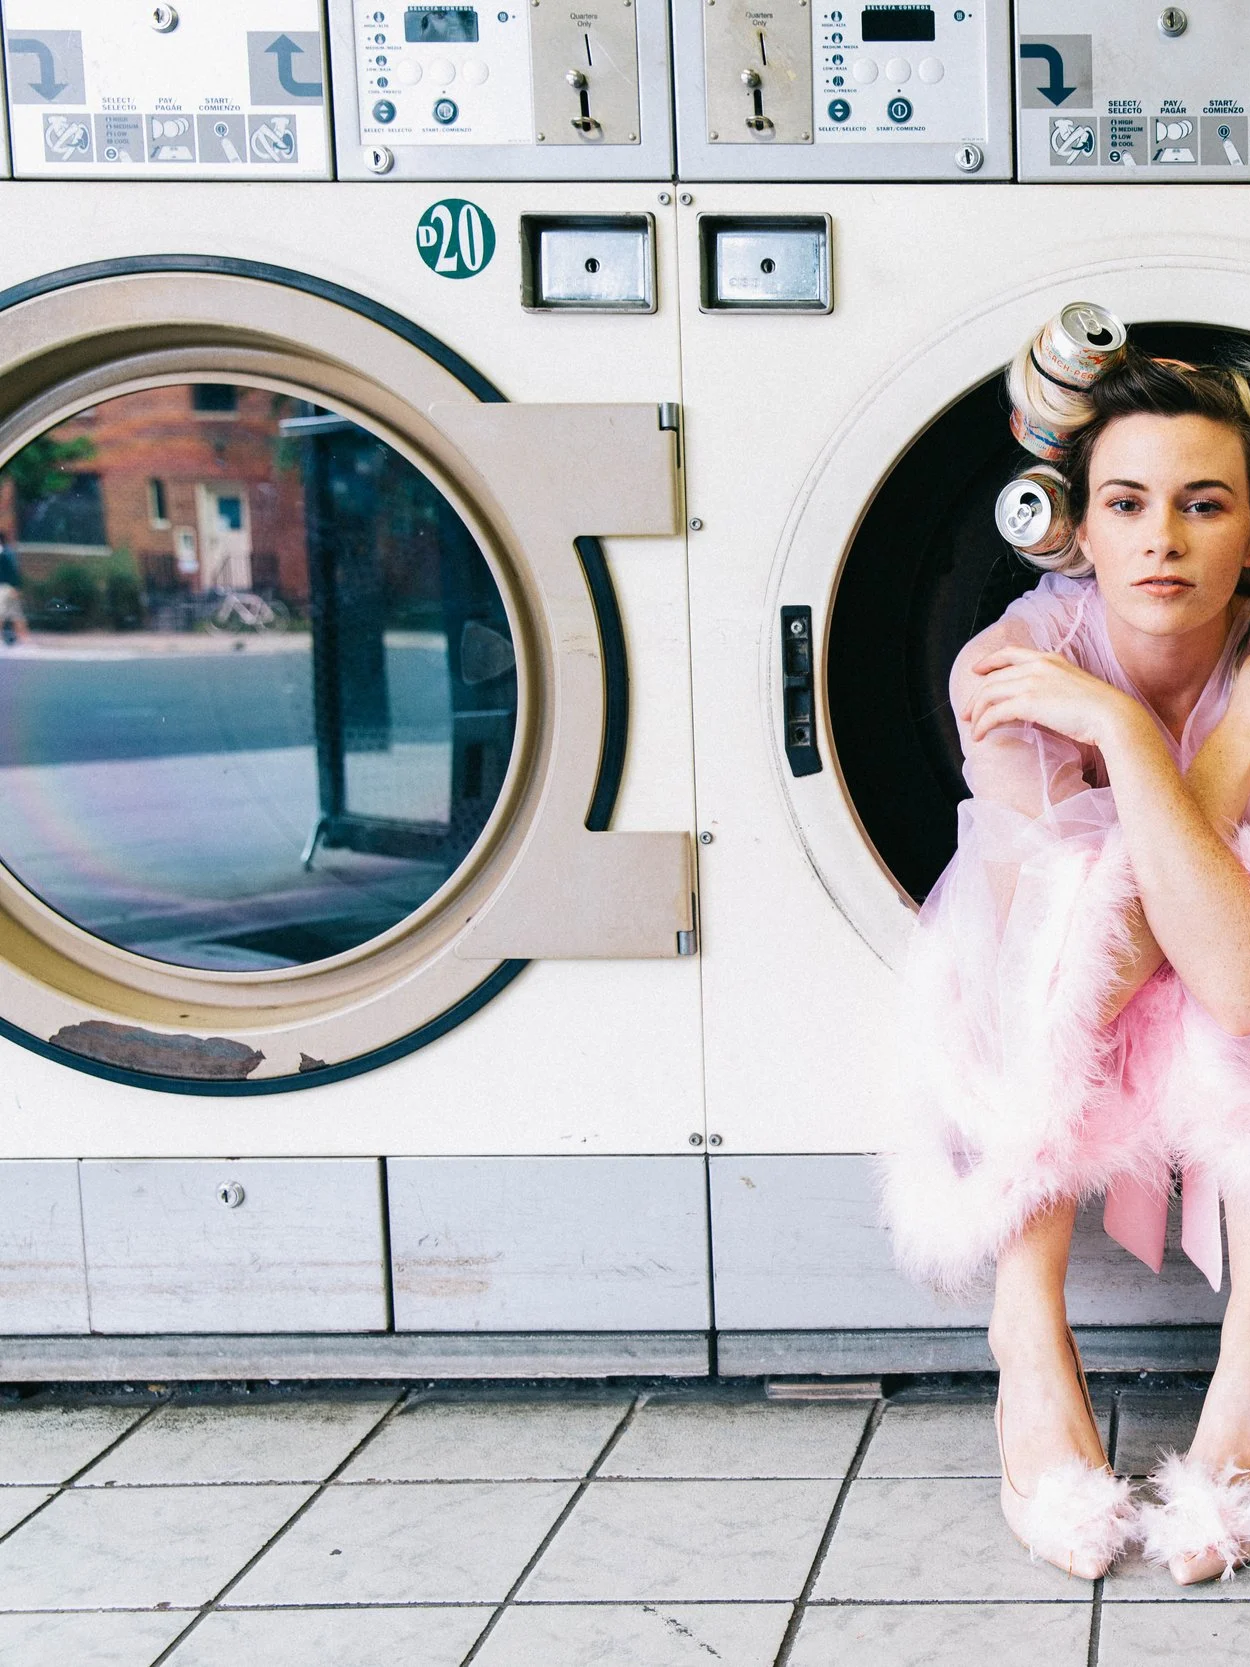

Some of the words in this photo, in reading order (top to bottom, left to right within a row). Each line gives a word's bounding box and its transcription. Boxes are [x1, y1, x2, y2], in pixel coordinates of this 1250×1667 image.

[570, 12, 598, 20] Quarters
[745, 11, 774, 19] Quarters
[577, 20, 592, 28] Only
[752, 19, 767, 27] Only
[418, 204, 485, 273] D20
